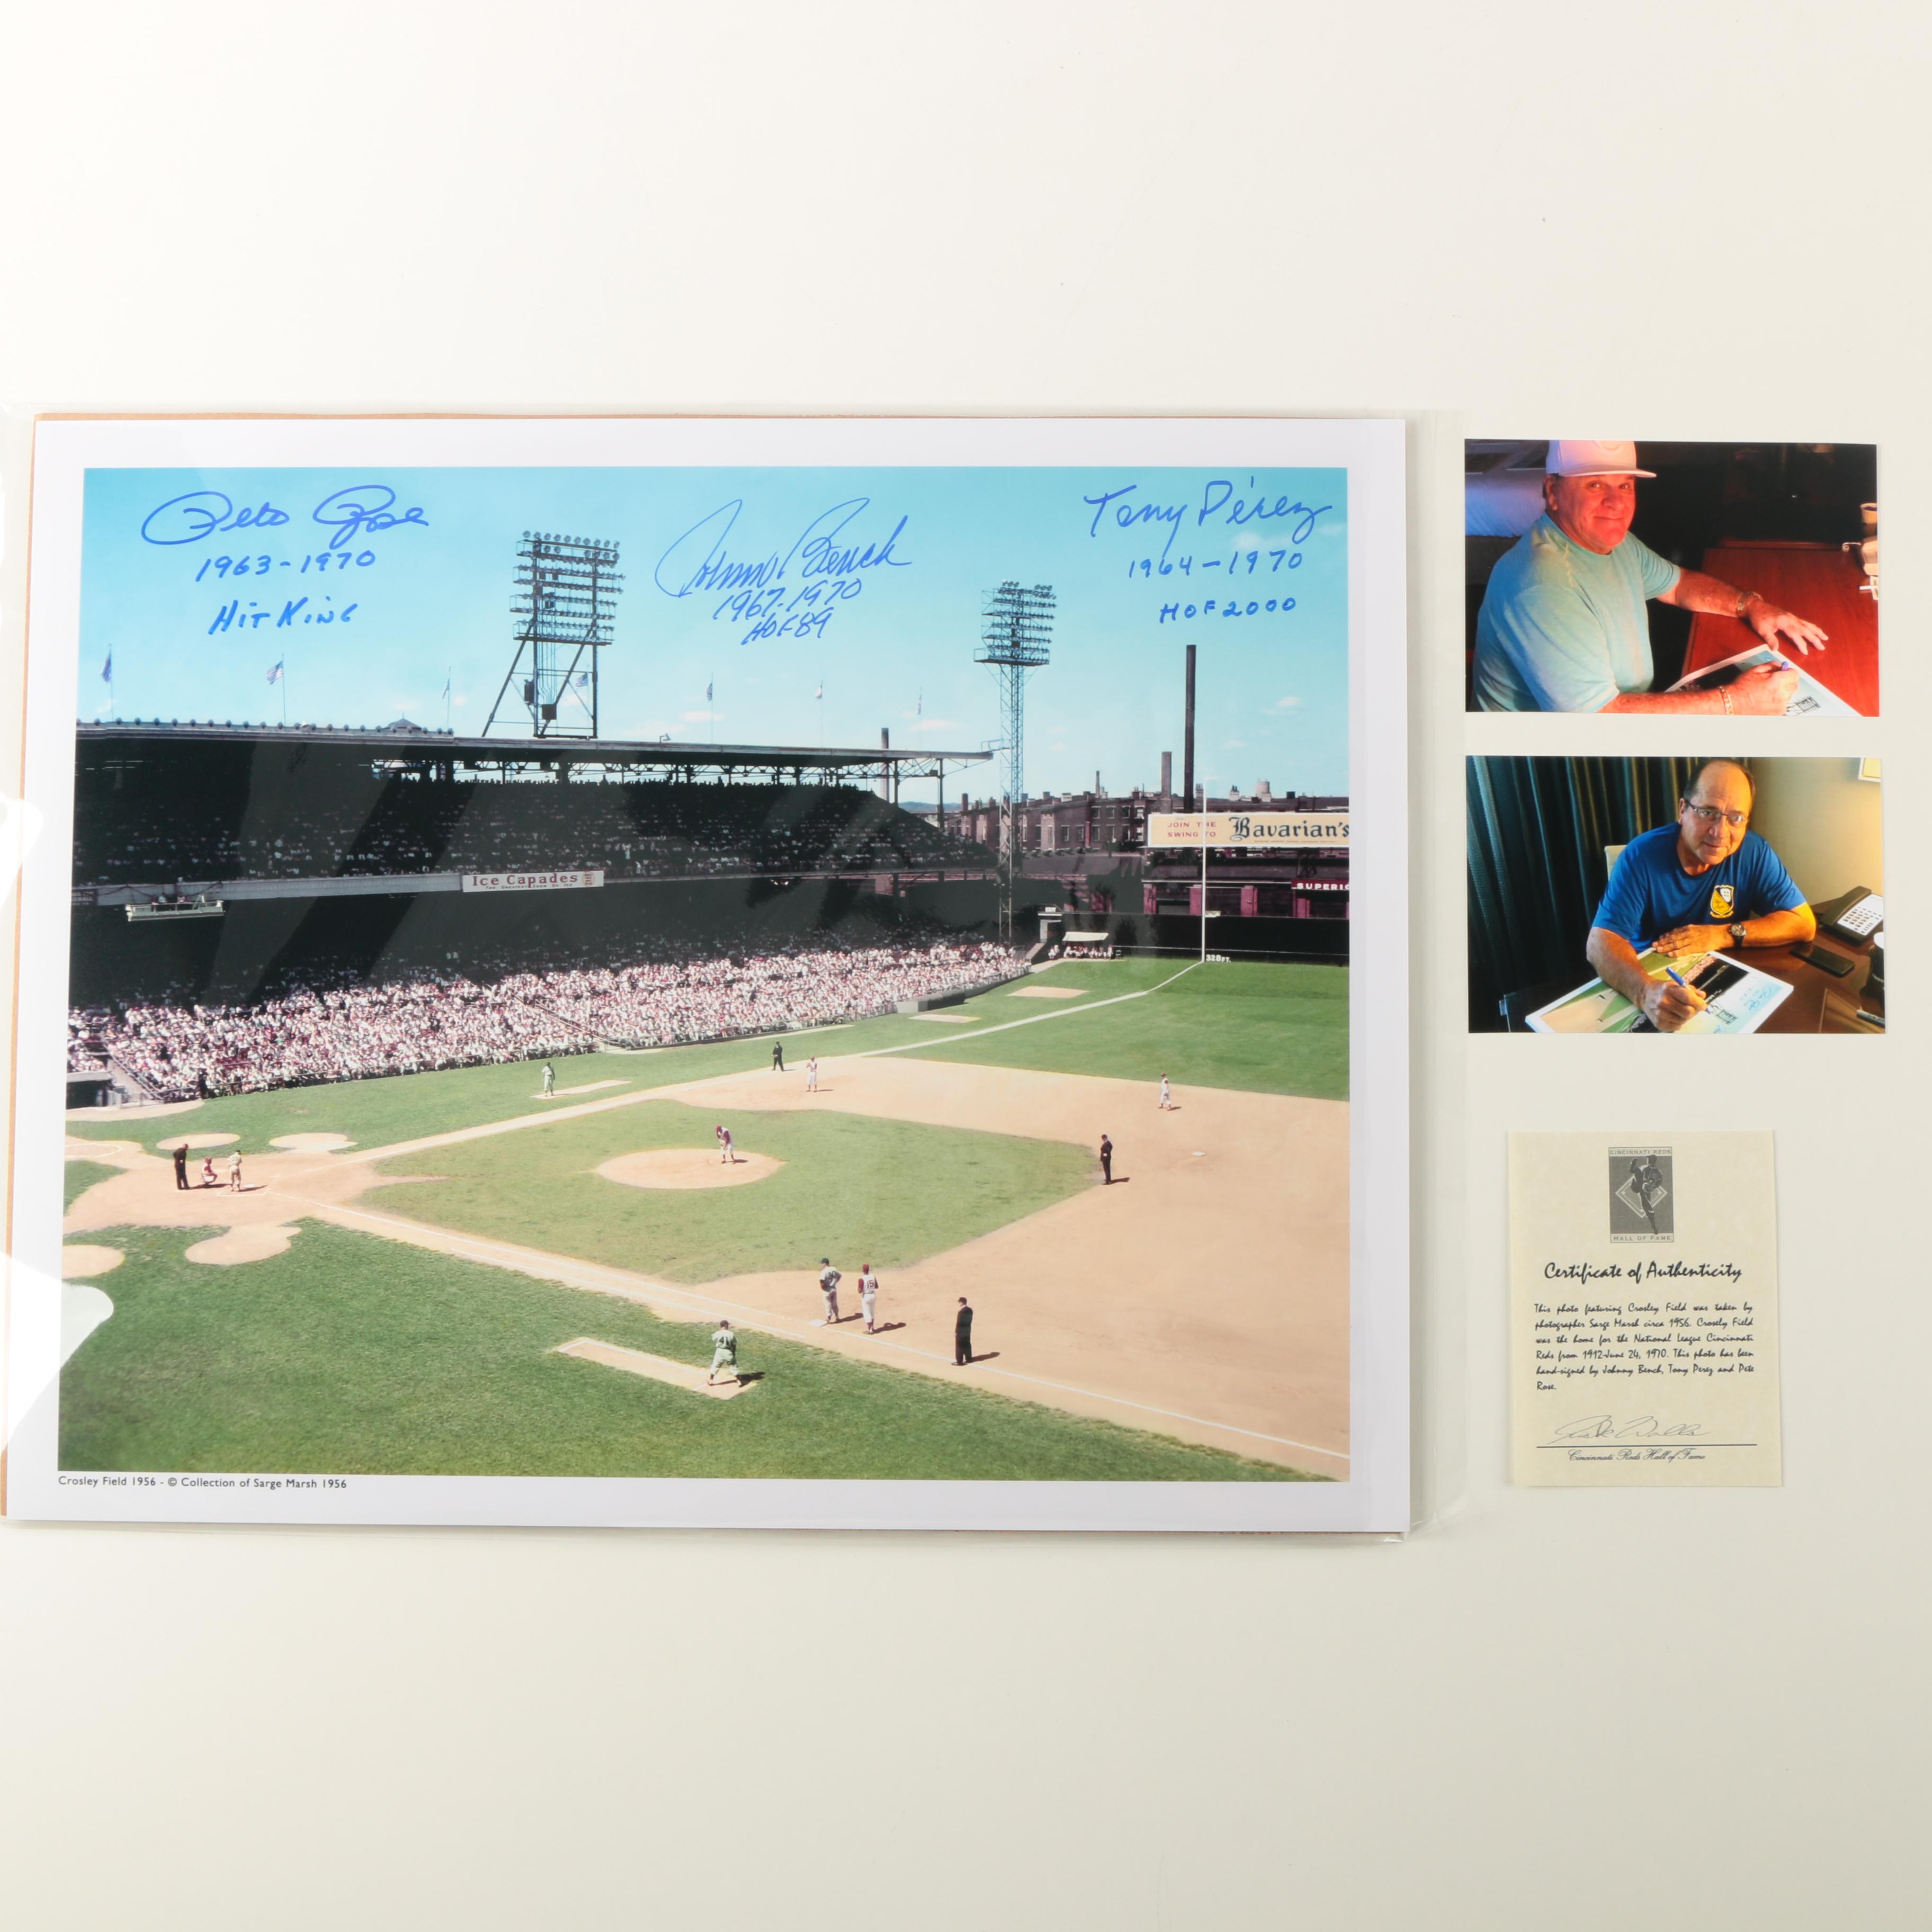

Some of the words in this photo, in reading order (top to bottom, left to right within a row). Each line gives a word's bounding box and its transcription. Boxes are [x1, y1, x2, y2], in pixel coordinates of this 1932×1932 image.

[1083, 484, 1188, 558] Tony
[472, 875, 499, 887] Ice
[506, 872, 578, 889] Capades
[1544, 1262, 1622, 1285] Certificate
[1627, 1262, 1642, 1284] of
[1645, 1260, 1742, 1283] Authenticity
[866, 1279, 874, 1289] 15
[1534, 1303, 1551, 1313] This
[1557, 1303, 1579, 1316] photo
[1585, 1303, 1622, 1316] featuring
[1627, 1302, 1659, 1315] Crosley
[1666, 1302, 1687, 1312] Field
[1714, 1303, 1738, 1311] taken
[1743, 1301, 1753, 1314] by
[1535, 1319, 1586, 1331] photographer
[1589, 1318, 1610, 1331] Sarge
[1614, 1318, 1640, 1327] Marsh
[1669, 1317, 1692, 1328] 1956.
[1732, 1317, 1754, 1327] Field
[719, 1336, 729, 1345] 41
[1556, 1334, 1568, 1344] the
[1573, 1334, 1594, 1344] home
[1598, 1334, 1612, 1347] for
[1616, 1334, 1629, 1343] the
[1633, 1333, 1672, 1343] National
[1677, 1333, 1702, 1346] League
[1706, 1332, 1754, 1343] Cincinnati
[1536, 1350, 1554, 1359] Reds
[1558, 1350, 1579, 1363] from
[1627, 1349, 1642, 1360] 24,
[1645, 1348, 1669, 1359] 1970.
[1673, 1348, 1690, 1358] This
[1693, 1348, 1716, 1361] photo
[1720, 1348, 1734, 1357] has
[1737, 1348, 1754, 1357] been
[1536, 1365, 1586, 1378] hand-signed
[1589, 1365, 1599, 1378] by
[1603, 1365, 1634, 1378] Johnny
[1638, 1364, 1664, 1375] Bench,
[1668, 1364, 1689, 1376] Tony
[1693, 1363, 1714, 1377] Perez
[1717, 1364, 1734, 1373] and
[1739, 1363, 1755, 1373] Pete
[1536, 1381, 1557, 1391] Rose.
[1568, 1449, 1613, 1461] Cincinnati
[1616, 1448, 1641, 1461] Reds
[1642, 1448, 1669, 1460] Hall
[1668, 1452, 1675, 1463] of
[1677, 1448, 1706, 1460] Fame
[58, 1475, 99, 1488] Crosley
[103, 1476, 127, 1486] Field
[132, 1477, 156, 1486] 1956
[181, 1477, 235, 1487] Collection
[239, 1478, 250, 1487] of
[253, 1478, 282, 1490] Sarge
[286, 1479, 317, 1488] Marsh
[323, 1479, 347, 1489] 1956
